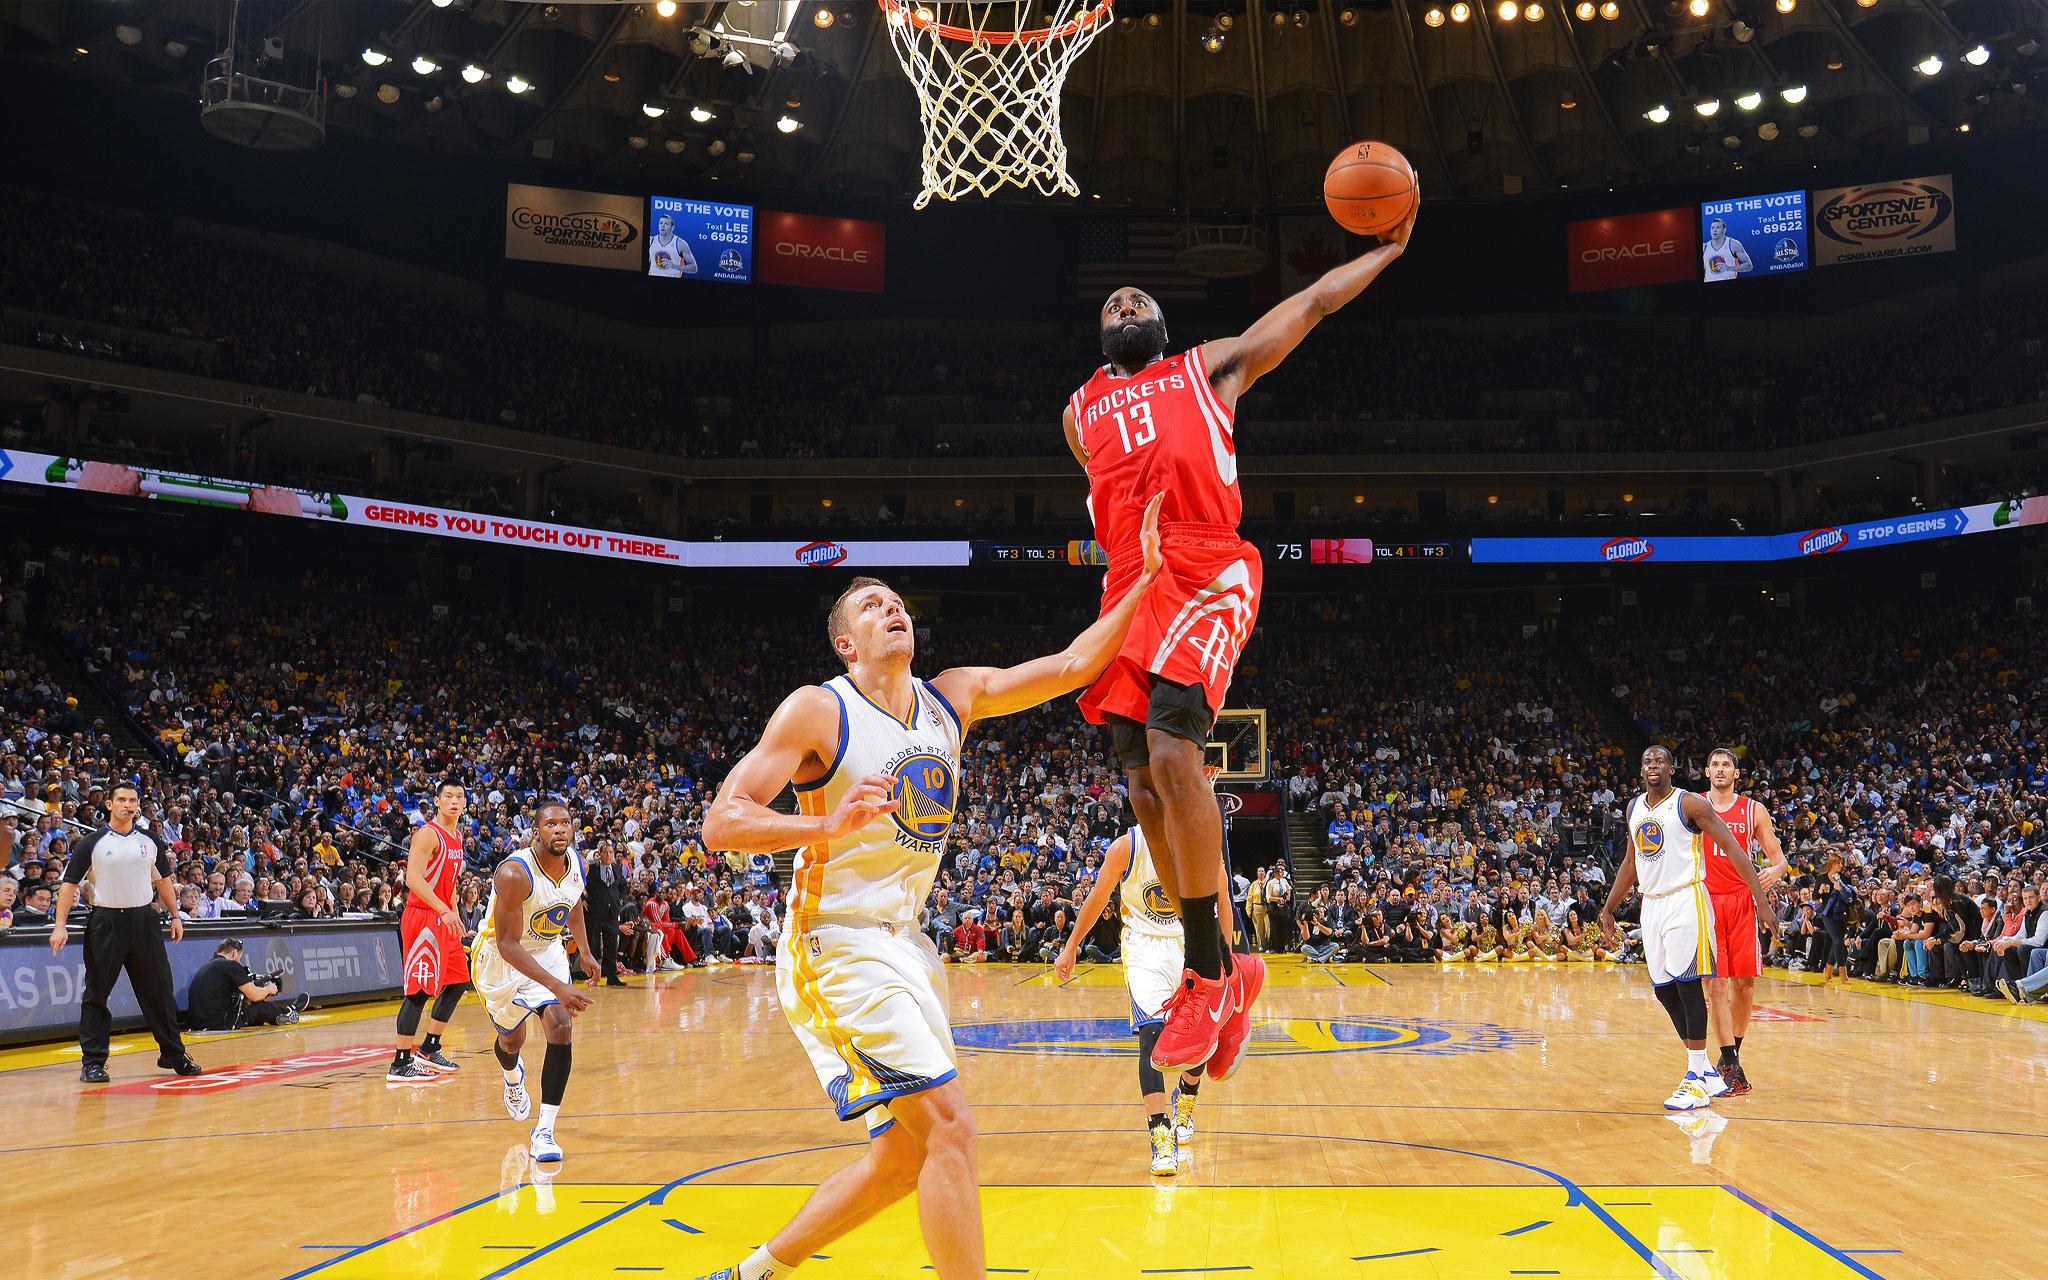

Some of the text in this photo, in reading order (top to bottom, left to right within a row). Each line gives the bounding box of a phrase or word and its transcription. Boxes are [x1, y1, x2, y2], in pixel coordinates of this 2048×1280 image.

[654, 199, 749, 219] DUB THE VOTE
[1705, 194, 1802, 215] DUB THE VOTE
[1825, 193, 1942, 221] SPORTSNET
[1757, 209, 1802, 224] Text LEE
[1847, 212, 1921, 230] CENTRAL
[533, 226, 621, 243] SPORTSNET
[706, 222, 748, 233] Text LEE
[710, 232, 748, 244] 69622
[1763, 221, 1802, 234] 69622
[775, 242, 867, 263] ORACLE
[1582, 240, 1676, 262] ORACLE
[1084, 374, 1185, 428] ROCKETS
[1112, 400, 1157, 454] 13
[365, 505, 680, 561] GERMS YOU TOUCH OUT THERE...
[1803, 518, 1946, 555] CLOROX STOP GERMS
[800, 544, 843, 565] CLOROX
[997, 550, 1009, 558] TF
[1010, 549, 1018, 559] 3
[1026, 550, 1044, 558] TOL
[1047, 550, 1055, 559] 3
[1276, 544, 1302, 560] 75
[1375, 548, 1393, 556] TOL
[1395, 547, 1403, 556] 4
[1423, 548, 1434, 556] TF
[1435, 547, 1444, 556] 3
[1606, 539, 1648, 561] CLOROX
[926, 745, 957, 770] STATE
[922, 766, 945, 789] 10
[1646, 825, 1658, 836] 23
[452, 862, 459, 883] 7
[556, 910, 564, 921] 0
[302, 946, 361, 981] ESPN
